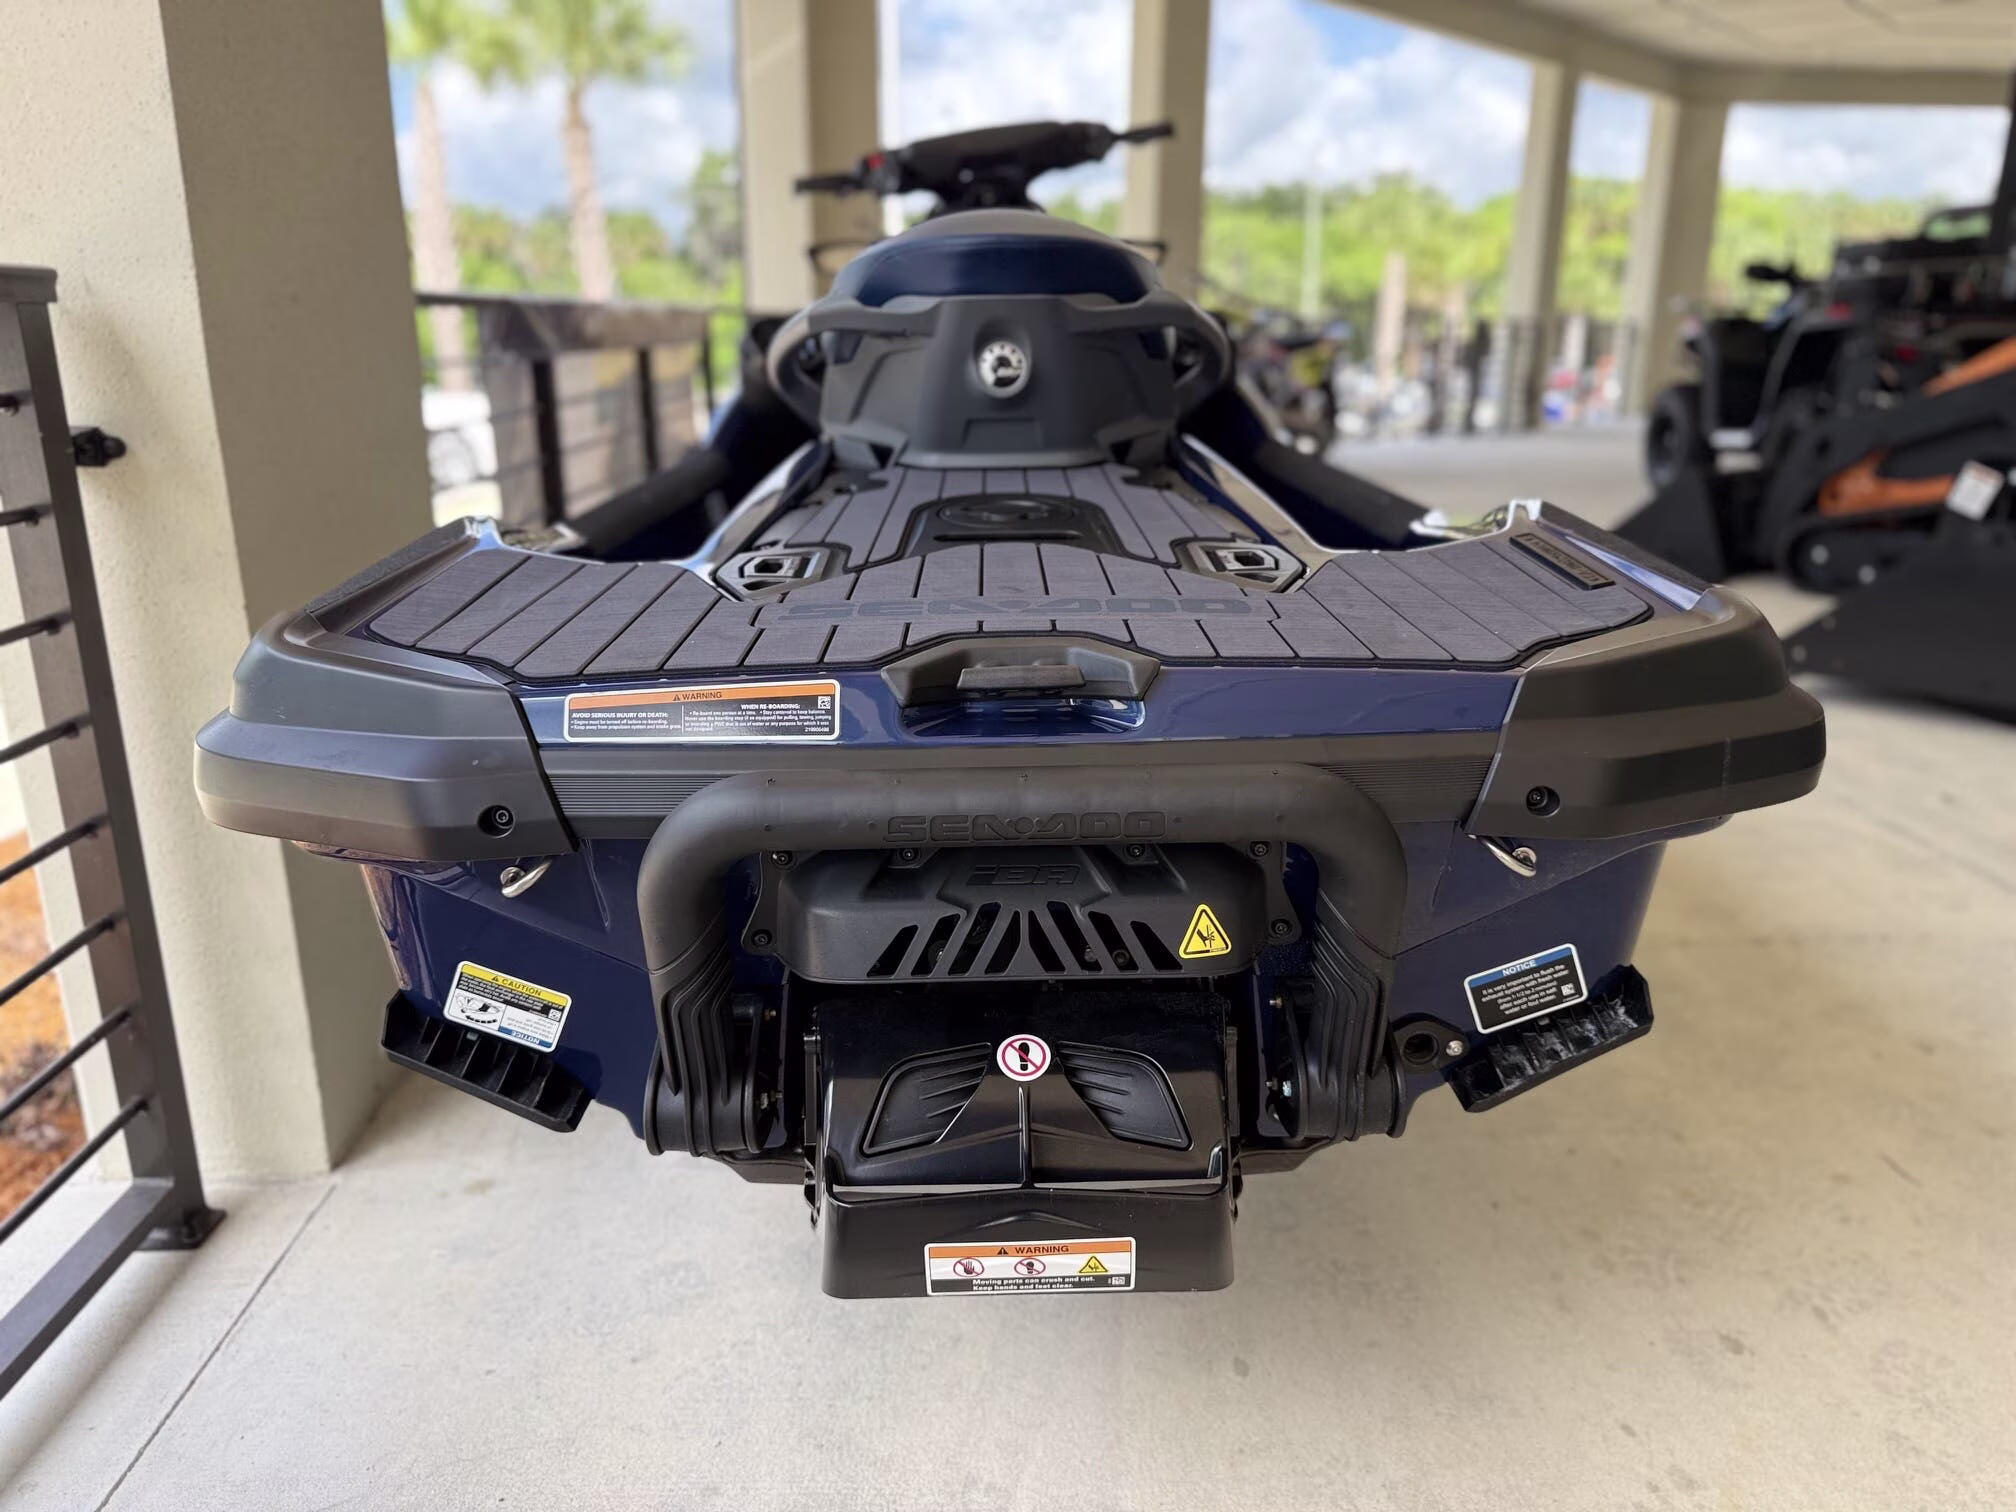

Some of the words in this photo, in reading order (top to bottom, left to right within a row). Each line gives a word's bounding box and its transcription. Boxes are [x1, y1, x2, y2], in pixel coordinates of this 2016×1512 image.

[682, 691, 722, 700] WARNING
[1502, 960, 1536, 976] NOTICE
[502, 978, 542, 996] CAUTION
[512, 1030, 540, 1044] NOTICE
[1014, 1246, 1070, 1254] WARNING
